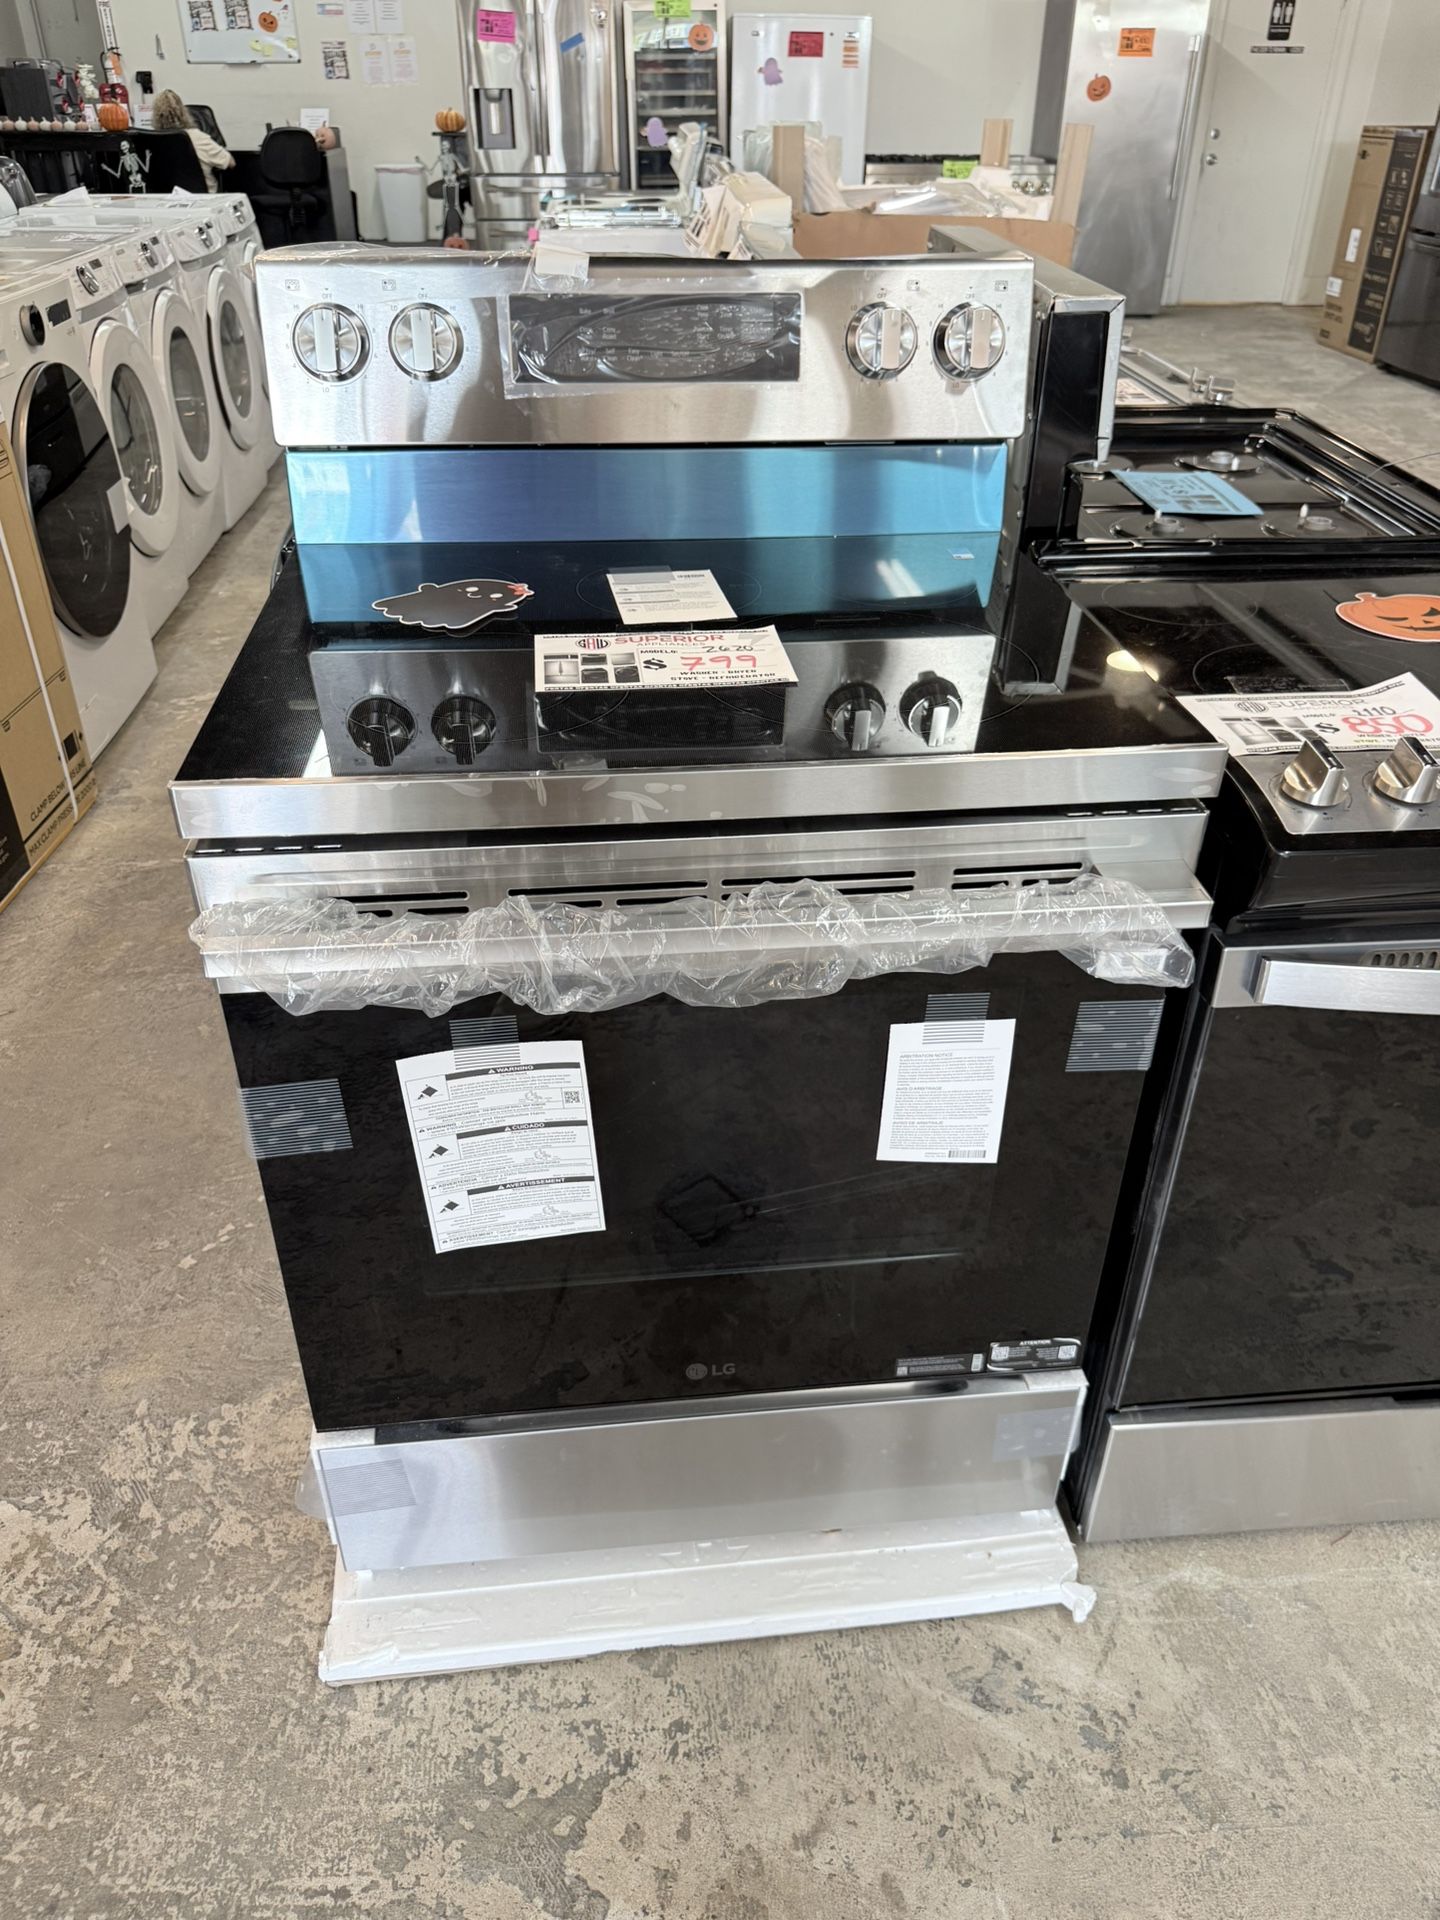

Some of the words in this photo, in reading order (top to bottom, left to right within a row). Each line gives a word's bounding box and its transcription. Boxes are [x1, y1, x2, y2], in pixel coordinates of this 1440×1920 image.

[615, 634, 724, 645] SUPERIOR
[643, 658, 668, 670] $
[680, 654, 757, 671] 799
[1268, 699, 1369, 708] SUPERIOR
[1314, 722, 1340, 733] $
[1341, 713, 1434, 735] 850
[496, 1065, 534, 1073] WARNING
[511, 1122, 545, 1131] CUIDADO
[506, 1177, 566, 1189] AVERTISSEMENT
[712, 1363, 736, 1376] LG
